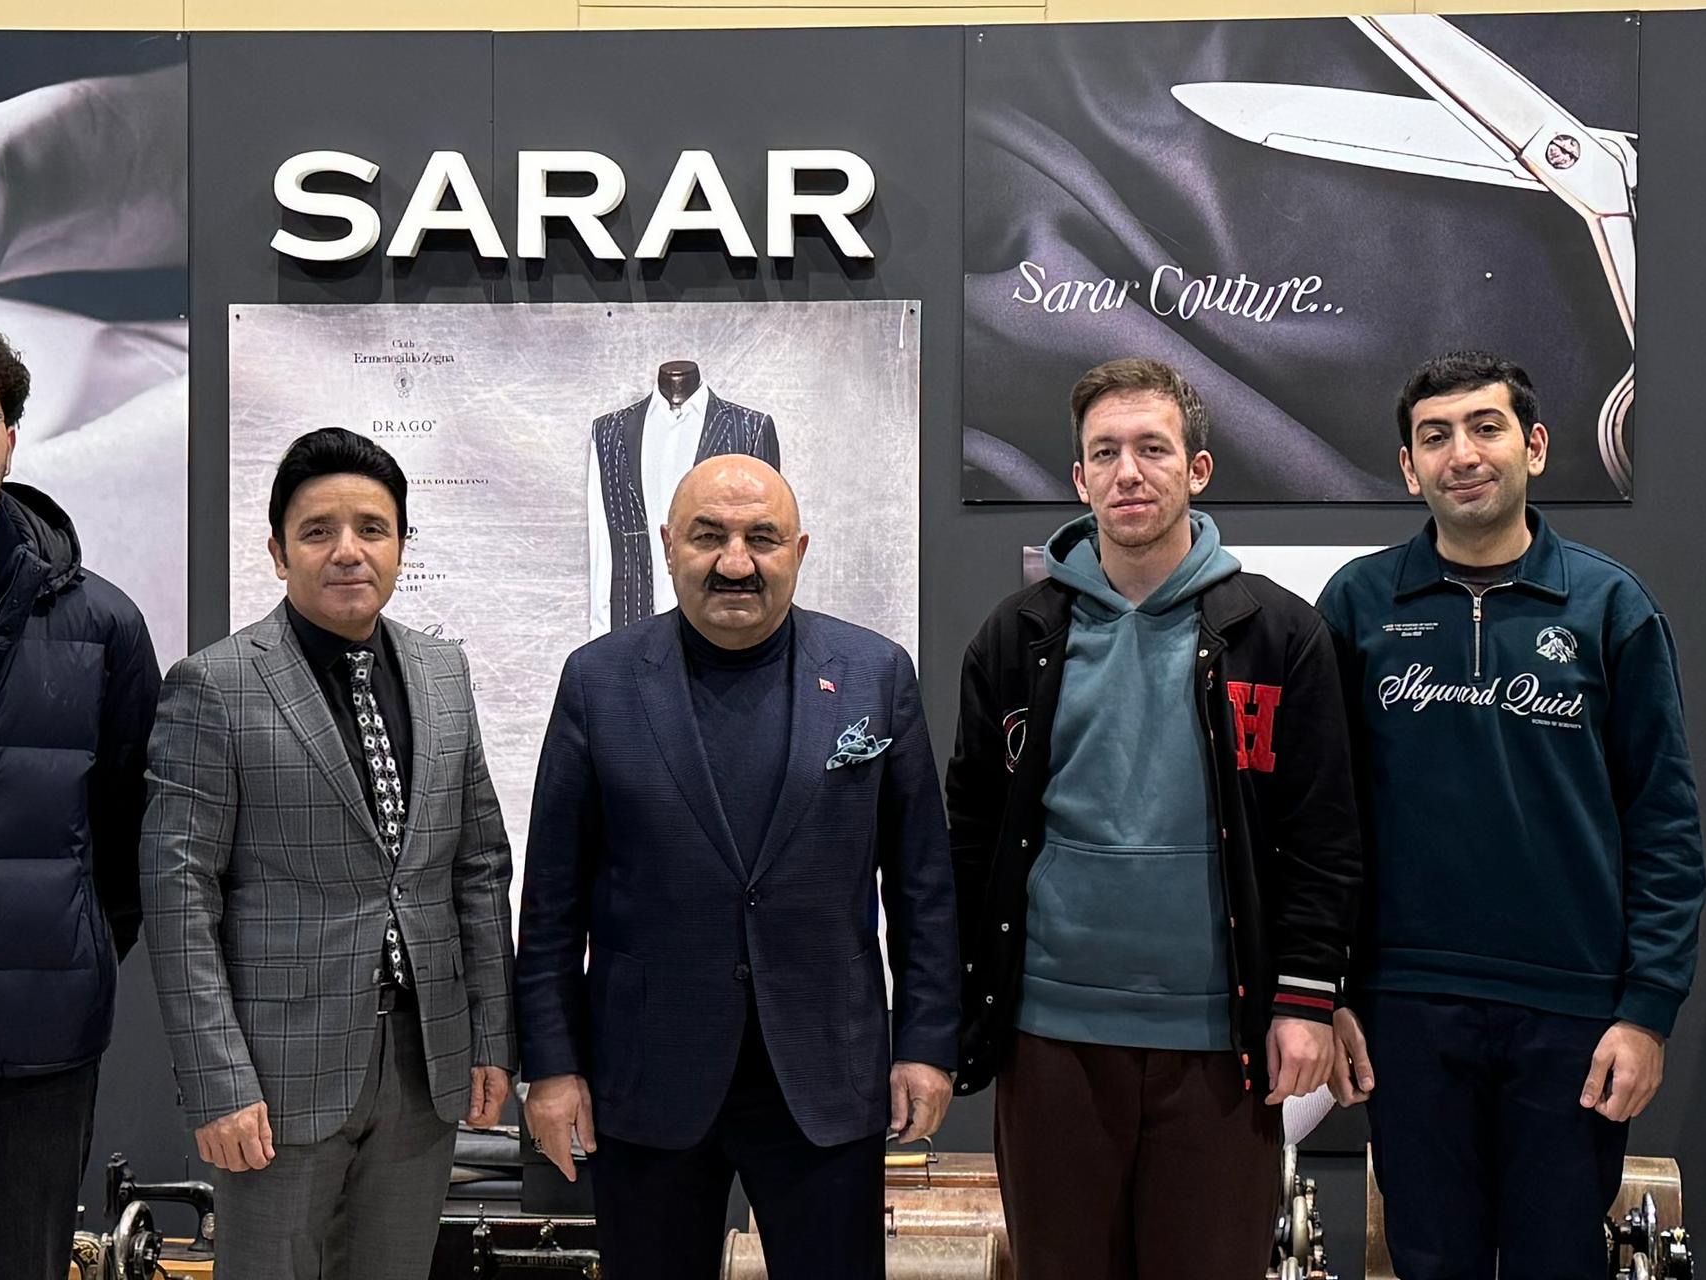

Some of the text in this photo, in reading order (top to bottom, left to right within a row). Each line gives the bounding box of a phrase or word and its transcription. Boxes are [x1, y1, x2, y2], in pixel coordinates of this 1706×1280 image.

[270, 150, 876, 261] SARAR
[1012, 261, 1140, 313] Sarar
[354, 352, 455, 365] Ermenegildo Zegna
[1378, 663, 1584, 717] Skyward Quiet
[1227, 681, 1282, 772] H
